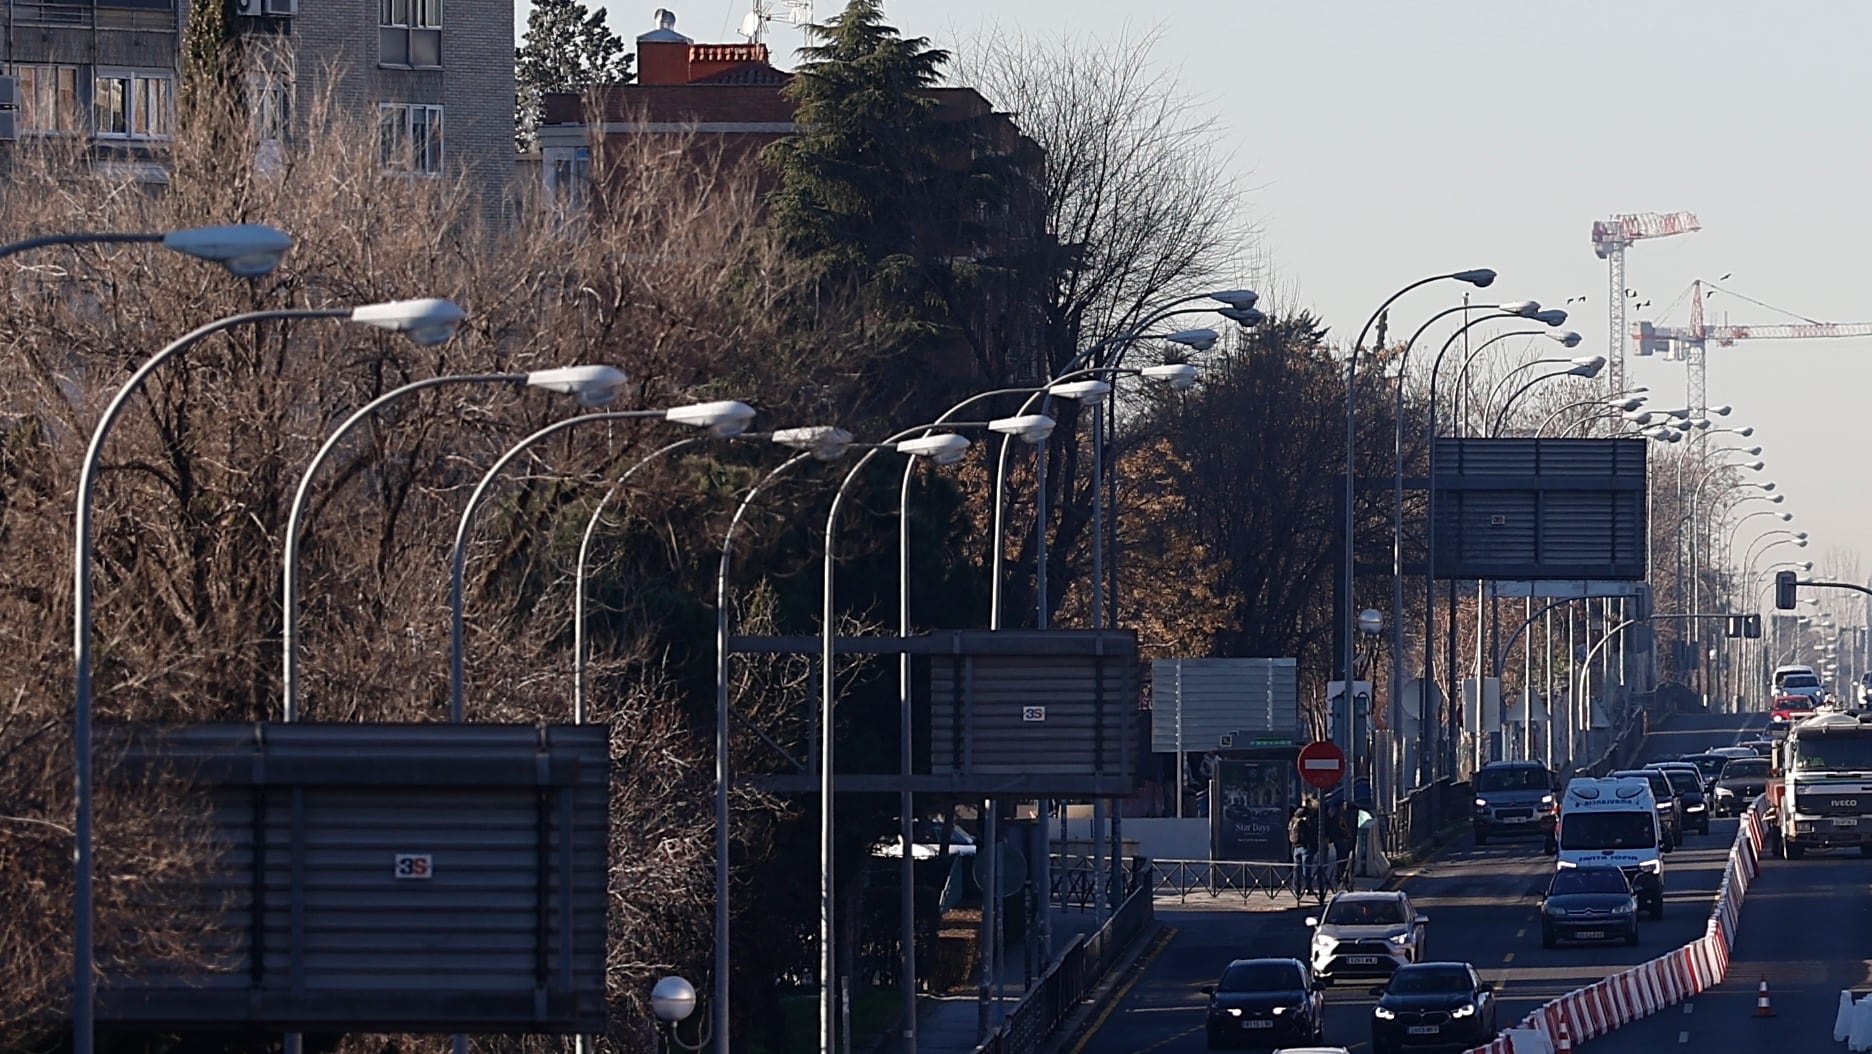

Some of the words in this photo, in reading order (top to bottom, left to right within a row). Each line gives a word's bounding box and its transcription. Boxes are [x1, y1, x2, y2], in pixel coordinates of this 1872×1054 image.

[1026, 708, 1042, 719] 3S
[1235, 823, 1251, 832] Star
[1252, 823, 1270, 833] Days
[400, 858, 427, 875] 3S
